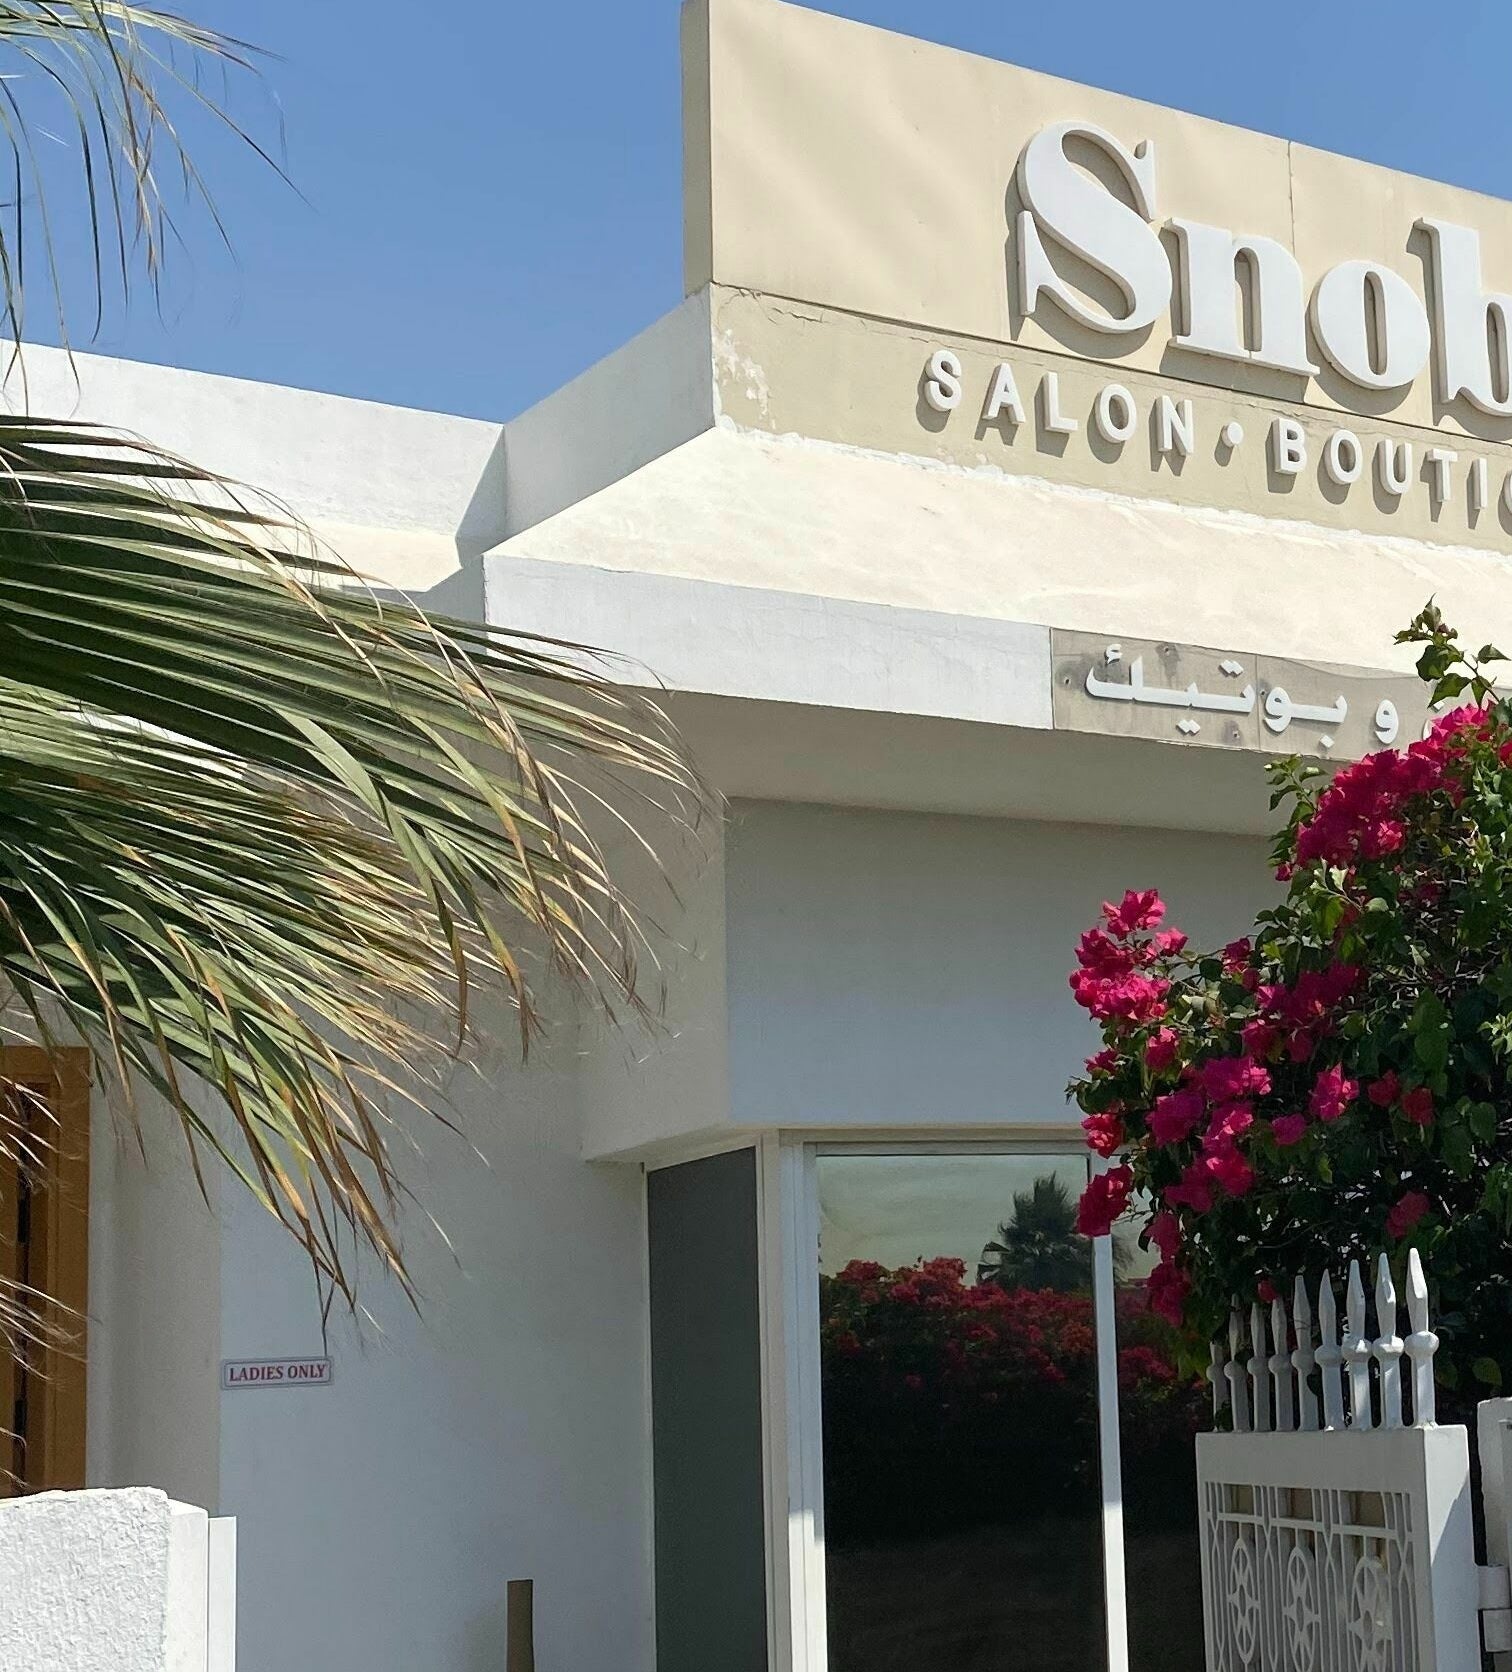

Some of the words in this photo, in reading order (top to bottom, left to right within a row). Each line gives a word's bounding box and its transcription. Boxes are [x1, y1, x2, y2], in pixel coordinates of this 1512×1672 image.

[923, 349, 1194, 458] SALON
[1086, 644, 1350, 749] بوتيك
[1374, 698, 1399, 745] و
[229, 1366, 284, 1382] LADIES
[287, 1363, 327, 1379] ONLY
